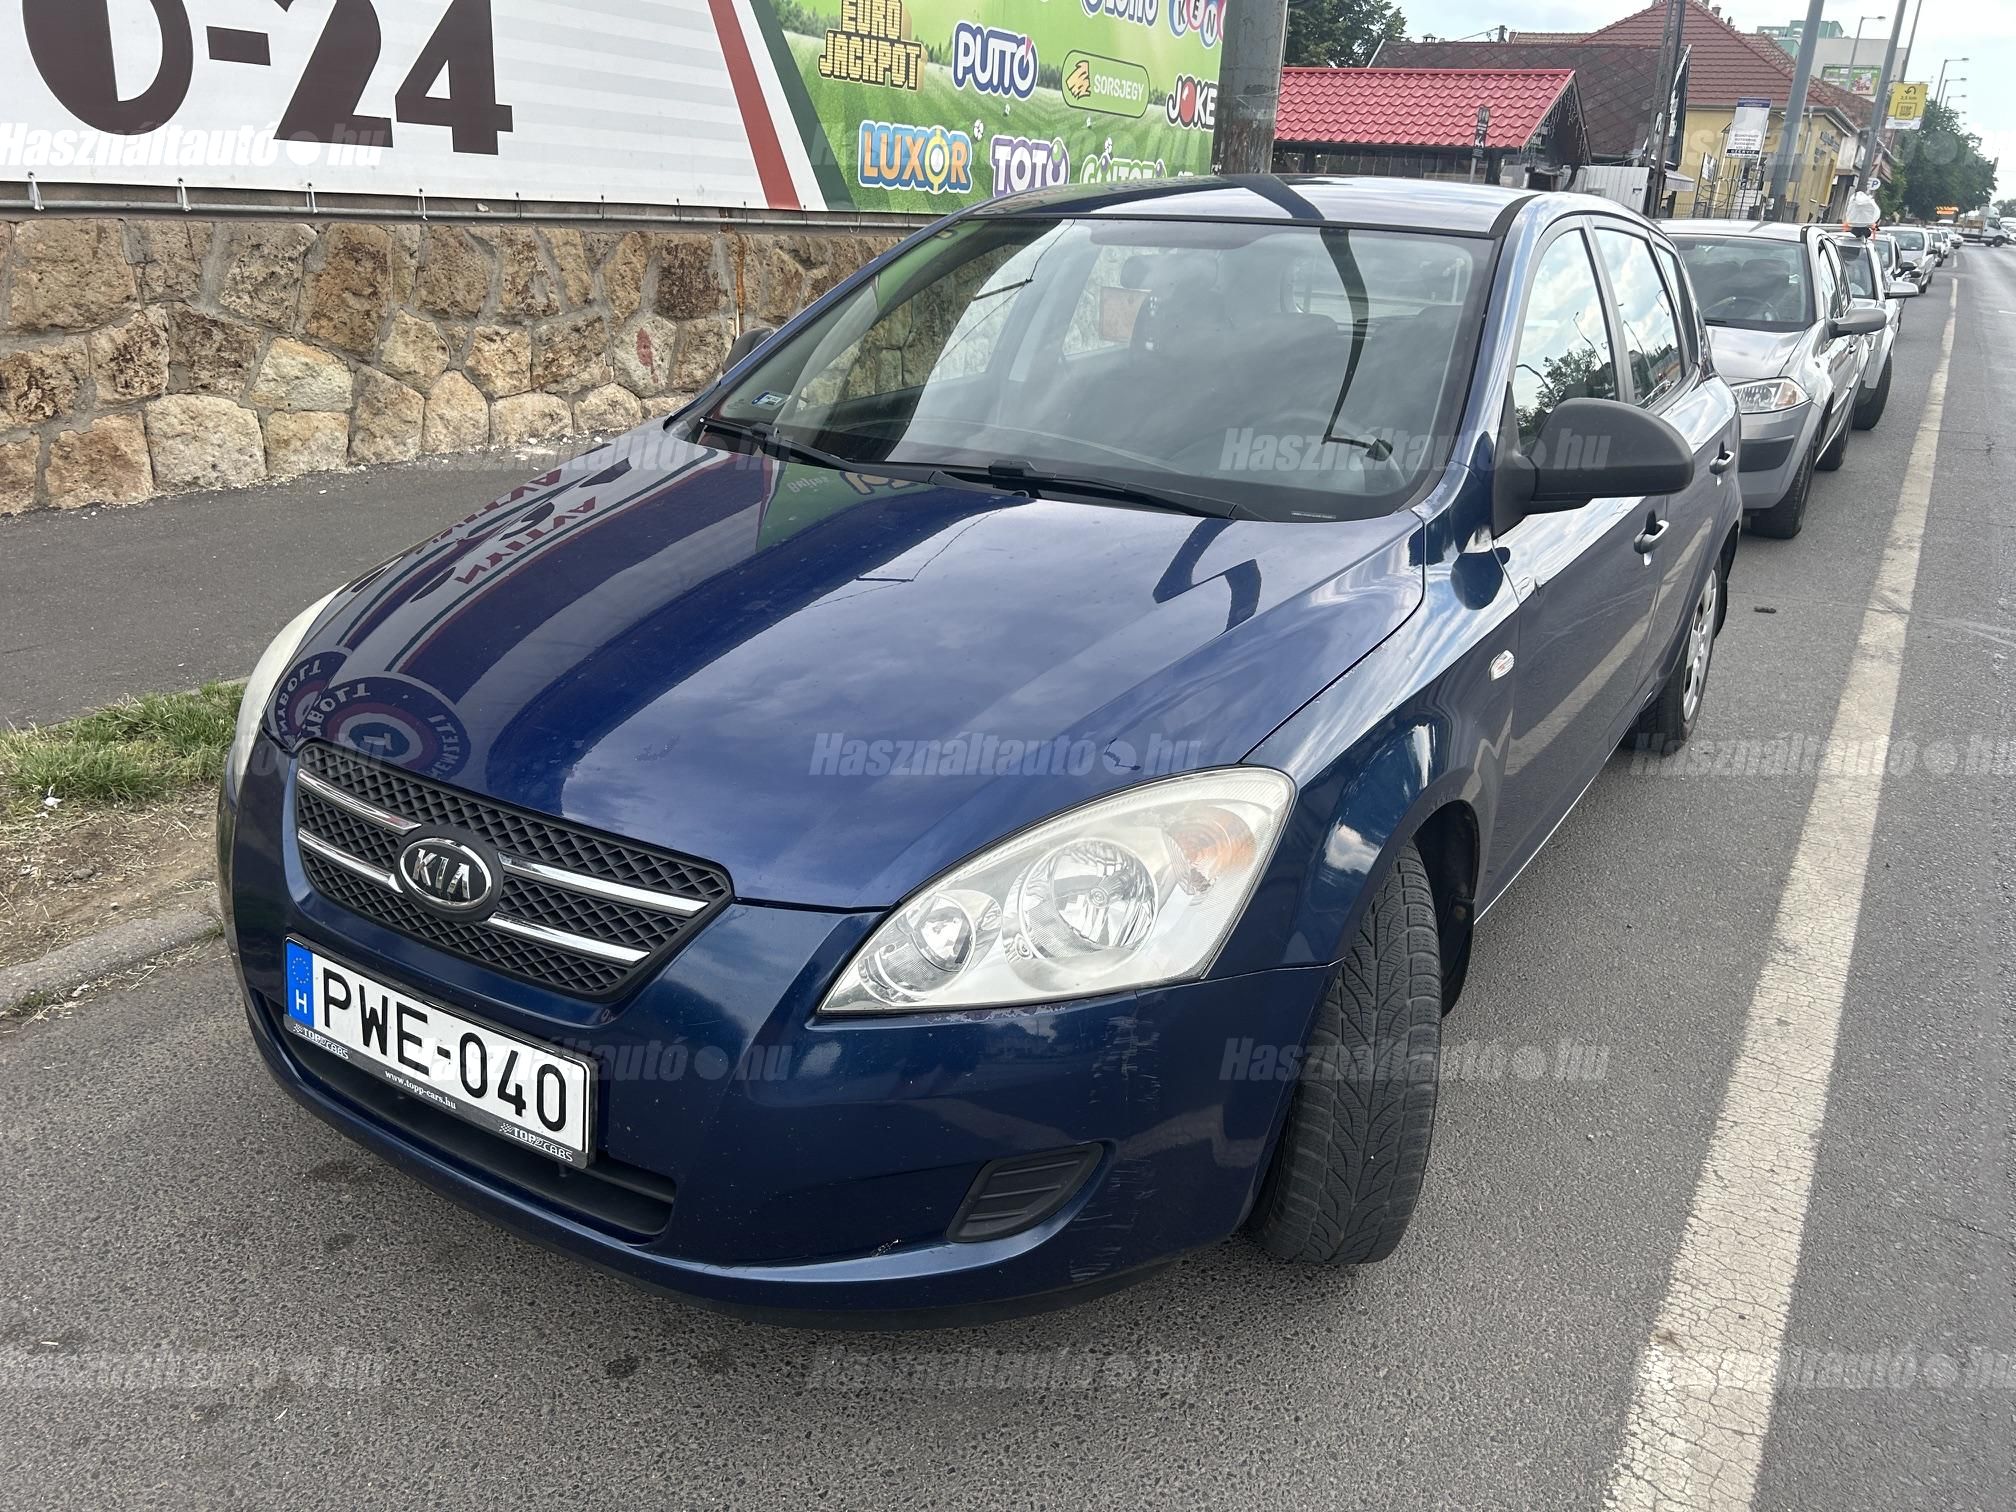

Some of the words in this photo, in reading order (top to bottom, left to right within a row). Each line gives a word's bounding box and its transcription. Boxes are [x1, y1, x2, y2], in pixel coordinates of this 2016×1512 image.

[1172, 0, 1225, 42] KEN
[820, 31, 922, 91] JACKPOT
[1094, 74, 1145, 102] SORSJEGY
[1167, 75, 1218, 129] JOKE
[862, 126, 969, 192] LUXOR
[412, 848, 470, 900] KIA
[295, 988, 308, 1015] H
[323, 966, 567, 1132] PWE-040
[384, 1069, 457, 1111] www.topp-cars.hu
